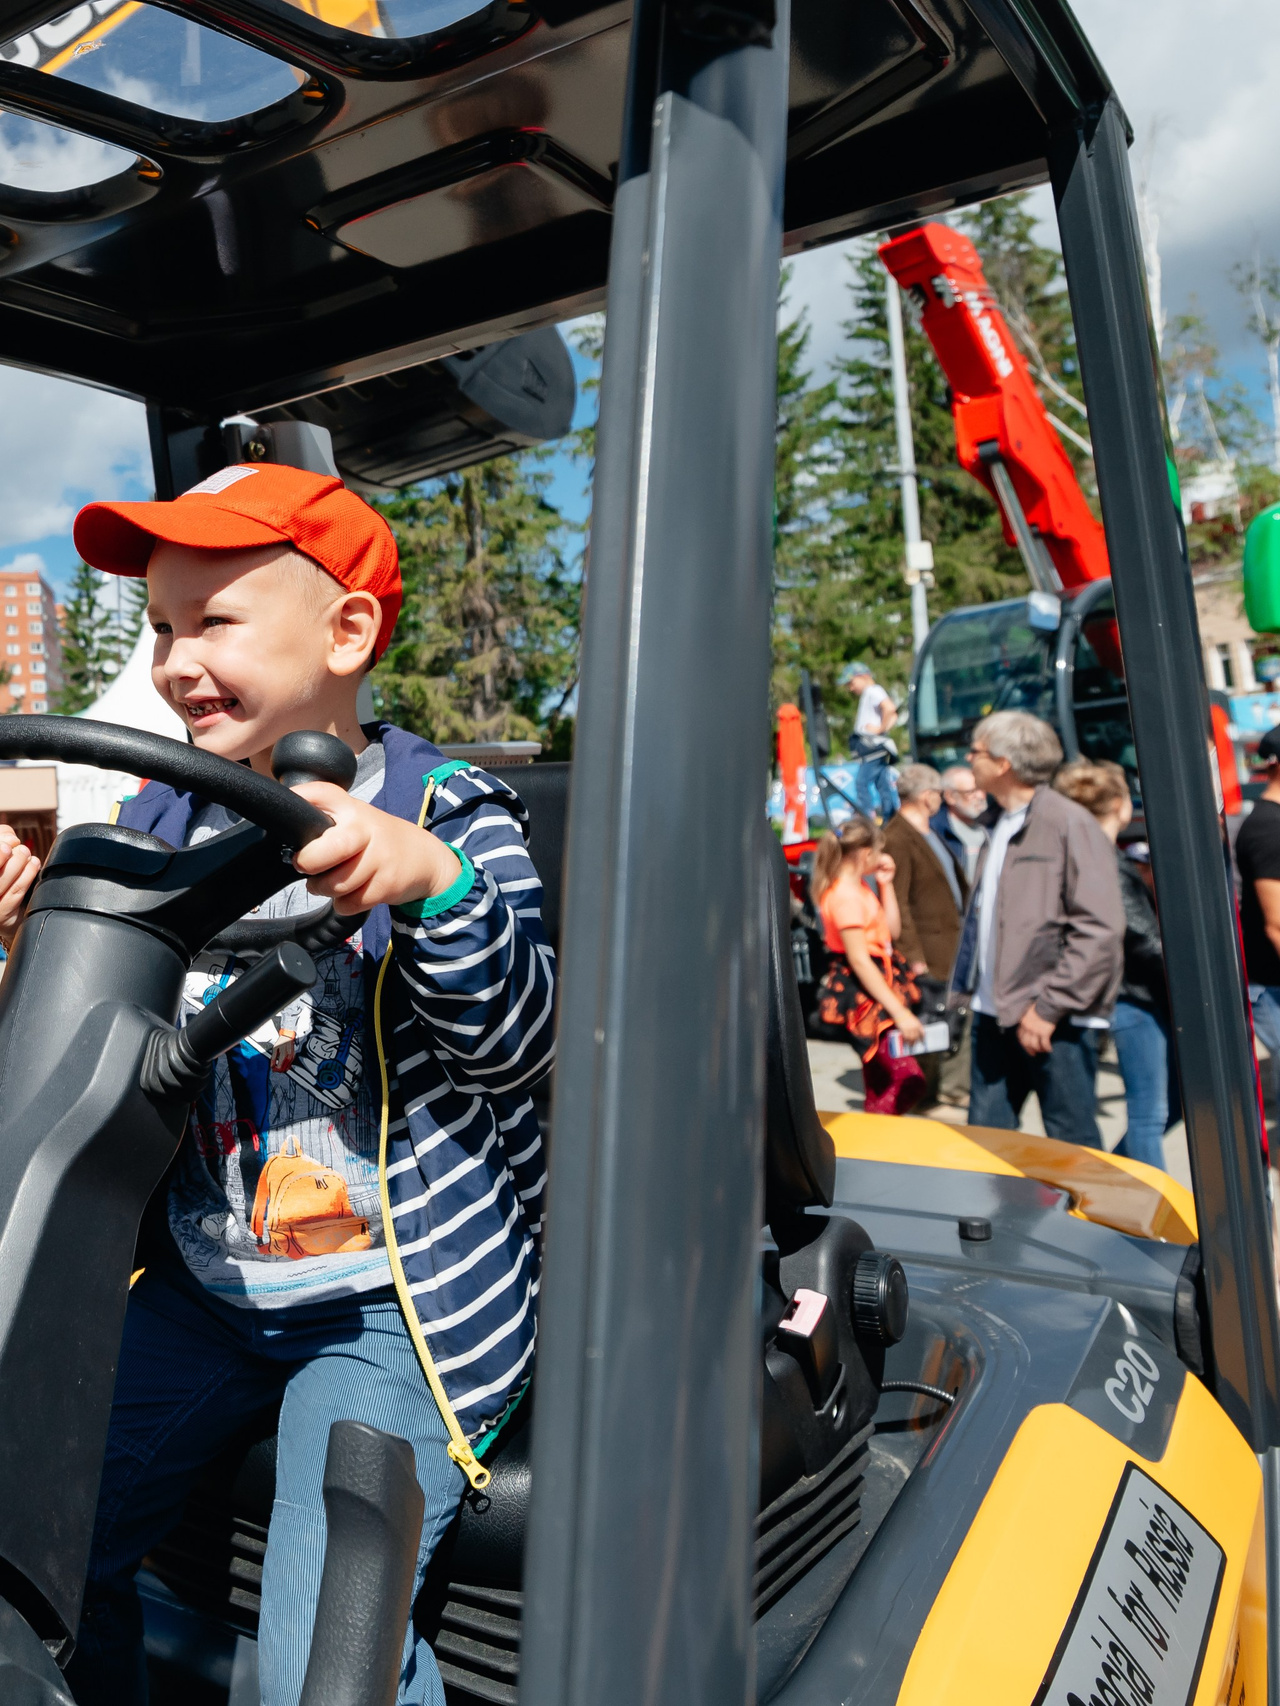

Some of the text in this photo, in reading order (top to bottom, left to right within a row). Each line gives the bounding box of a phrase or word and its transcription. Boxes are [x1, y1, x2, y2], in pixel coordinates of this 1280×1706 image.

[1104, 1341, 1160, 1424] C20
[1124, 1497, 1195, 1614] Russia
[1107, 1579, 1170, 1662] for
